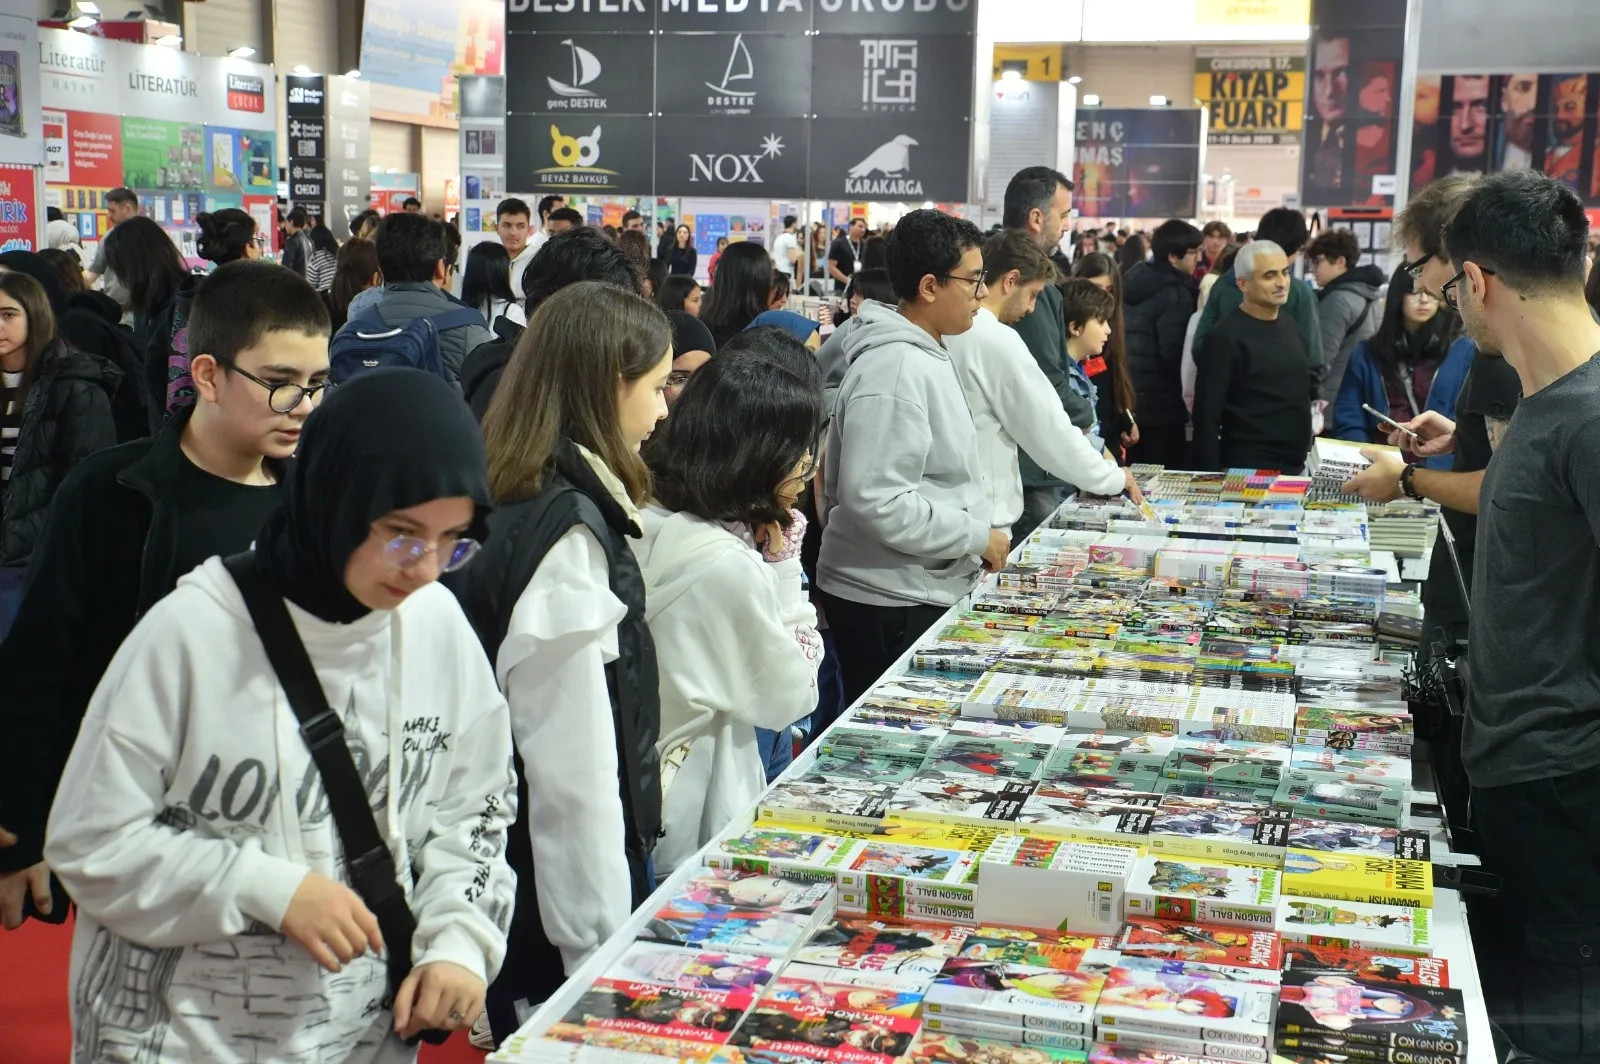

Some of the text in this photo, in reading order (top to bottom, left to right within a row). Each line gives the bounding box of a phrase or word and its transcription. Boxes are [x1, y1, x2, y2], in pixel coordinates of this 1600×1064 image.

[38, 42, 106, 73] Literatür
[1041, 56, 1050, 76] 1
[129, 69, 198, 97] LİTERATÜR
[1210, 70, 1289, 98] KİTAP
[547, 98, 607, 109] genç DESTEK
[708, 96, 754, 106] DESTEK
[1209, 101, 1287, 128] FUARI
[689, 153, 764, 183] NOX
[541, 174, 608, 185] BEYAZ BAYKUŞ
[845, 178, 923, 195] KARAKARGA
[1222, 848, 1239, 856] Dogs
[1240, 849, 1256, 858] Stray
[1258, 851, 1281, 860] Bungou
[780, 871, 802, 881] BALL
[916, 887, 939, 899] BALL
[940, 889, 973, 903] DRAGON
[1368, 894, 1387, 904] FISH
[1388, 895, 1420, 908] BANANA
[917, 904, 940, 916] BALL
[941, 905, 974, 920] DRAGON
[1209, 909, 1233, 919] BALL
[1234, 912, 1272, 924] DRAGON
[628, 983, 728, 1004] Hanako-Kun
[793, 1005, 895, 1026] Hanako-Kun
